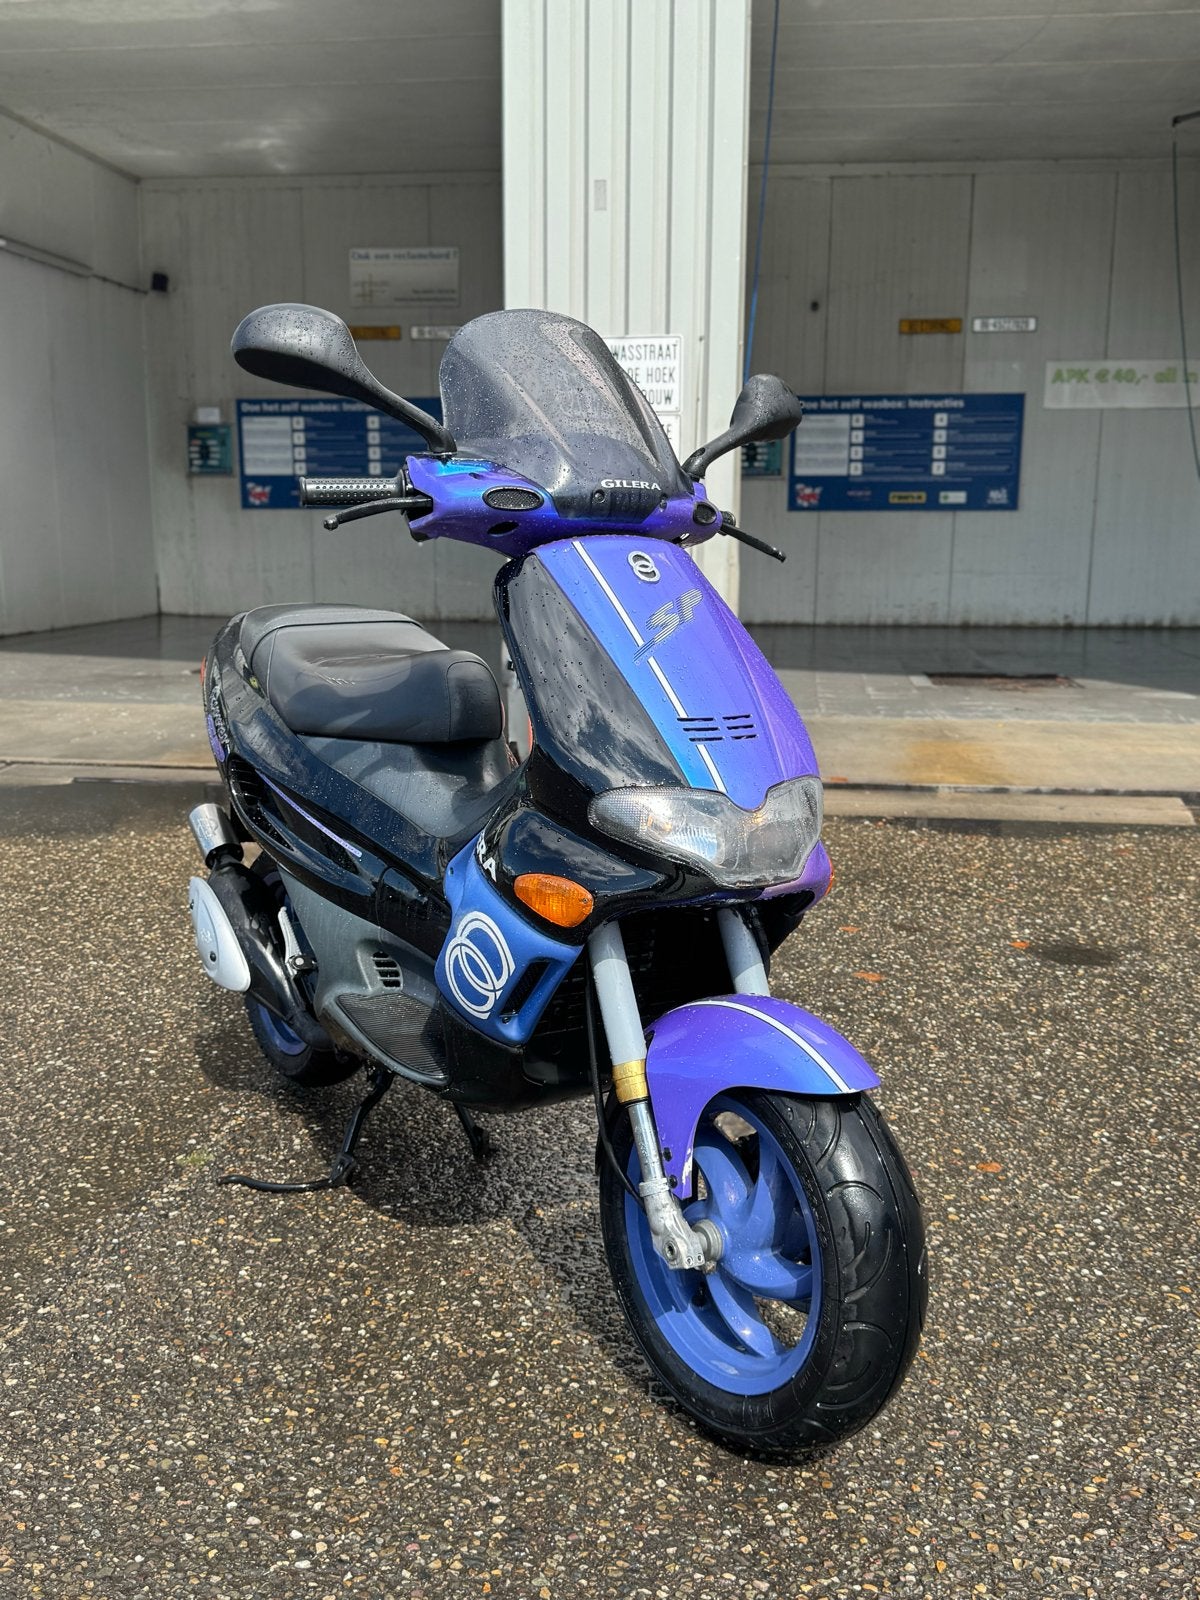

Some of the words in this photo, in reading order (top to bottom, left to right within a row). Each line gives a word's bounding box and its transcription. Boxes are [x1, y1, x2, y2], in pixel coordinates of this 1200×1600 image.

[611, 343, 678, 361] WASSTRAAT
[647, 366, 676, 384] HOEK
[1051, 367, 1089, 384] APK
[908, 397, 965, 409] Instructies
[600, 478, 662, 491] GILERA
